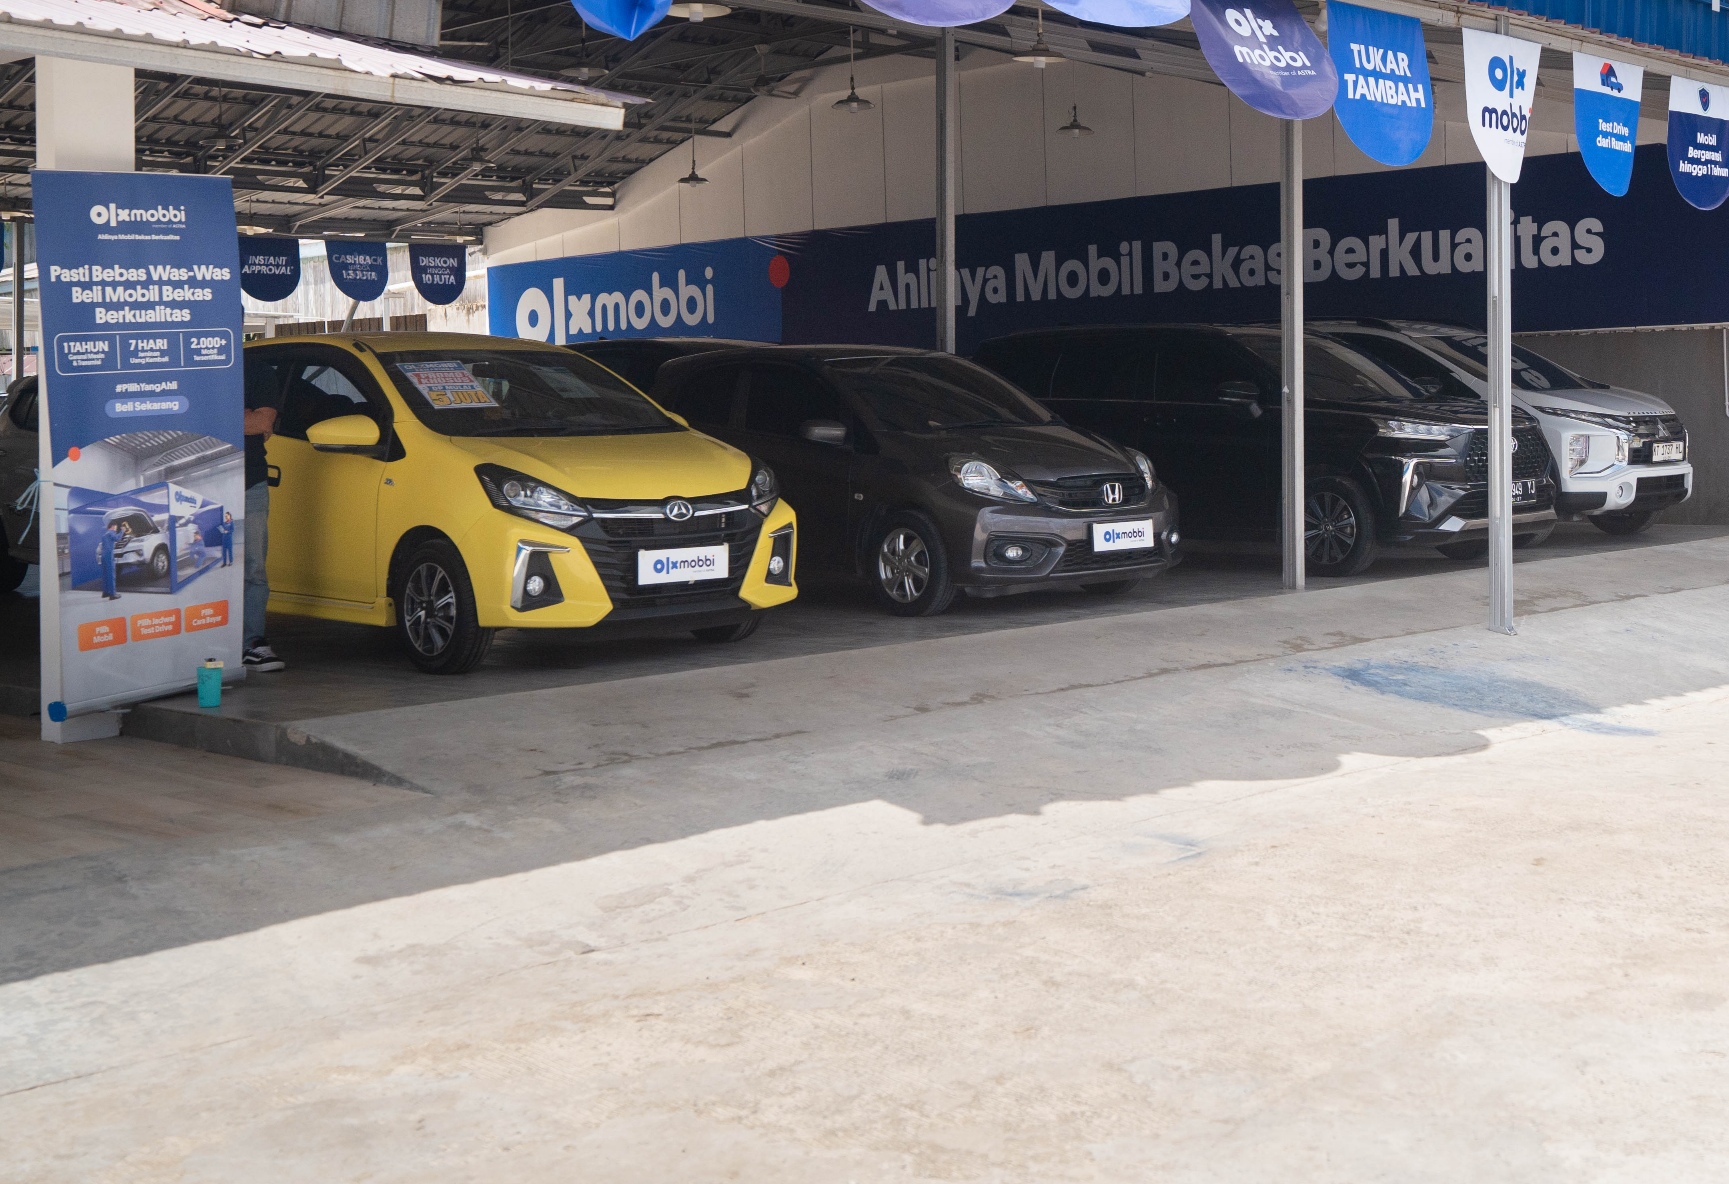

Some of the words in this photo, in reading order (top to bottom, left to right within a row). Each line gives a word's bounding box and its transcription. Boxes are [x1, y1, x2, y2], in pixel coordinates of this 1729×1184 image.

[1225, 8, 1279, 42] olx
[1234, 44, 1311, 67] mobbi
[1350, 43, 1411, 77] TUKAR
[1488, 55, 1526, 98] olx
[1344, 74, 1425, 107] TAMBAH
[1598, 119, 1613, 133] Test
[1613, 121, 1629, 136] Drive
[1596, 135, 1610, 148] dari
[1611, 138, 1631, 152] Rumah
[1697, 132, 1716, 146] Mobil
[1688, 146, 1722, 162] Bergaransi
[1679, 160, 1707, 176] hingga
[1711, 165, 1728, 177] Tahun
[90, 203, 186, 226] olxmobbi
[249, 256, 287, 265] INSTANT
[332, 254, 382, 265] CASHBACK
[419, 257, 457, 267] DISKON
[1015, 240, 1143, 302] Mobil
[1152, 233, 1282, 294] Bekas
[1303, 208, 1604, 283] Berkuatas
[50, 265, 89, 282] Pasti
[92, 265, 147, 282] Bebas
[149, 265, 231, 281] Was-Was
[422, 274, 431, 284] 10
[434, 274, 456, 284] JUTA
[72, 286, 102, 303] Beli
[105, 285, 159, 302] Mobil
[162, 285, 212, 301] Bekas
[516, 266, 715, 345] olxmobbi
[95, 306, 191, 324] Berkualitas
[63, 343, 68, 353] 1
[69, 341, 109, 353] TAHUN
[129, 340, 136, 350] 7
[138, 339, 168, 350] HARI
[190, 337, 227, 348] 2.000+
[115, 381, 178, 392] #PilihYangAhli
[115, 403, 134, 412] Beli
[135, 401, 179, 411] Sekarang
[428, 391, 452, 406] 5
[451, 391, 491, 404] JUTA
[1104, 528, 1144, 543] olxmobbi
[653, 555, 715, 574] olxmobbi
[155, 624, 173, 632] Drive
[93, 634, 113, 643] Mobil
